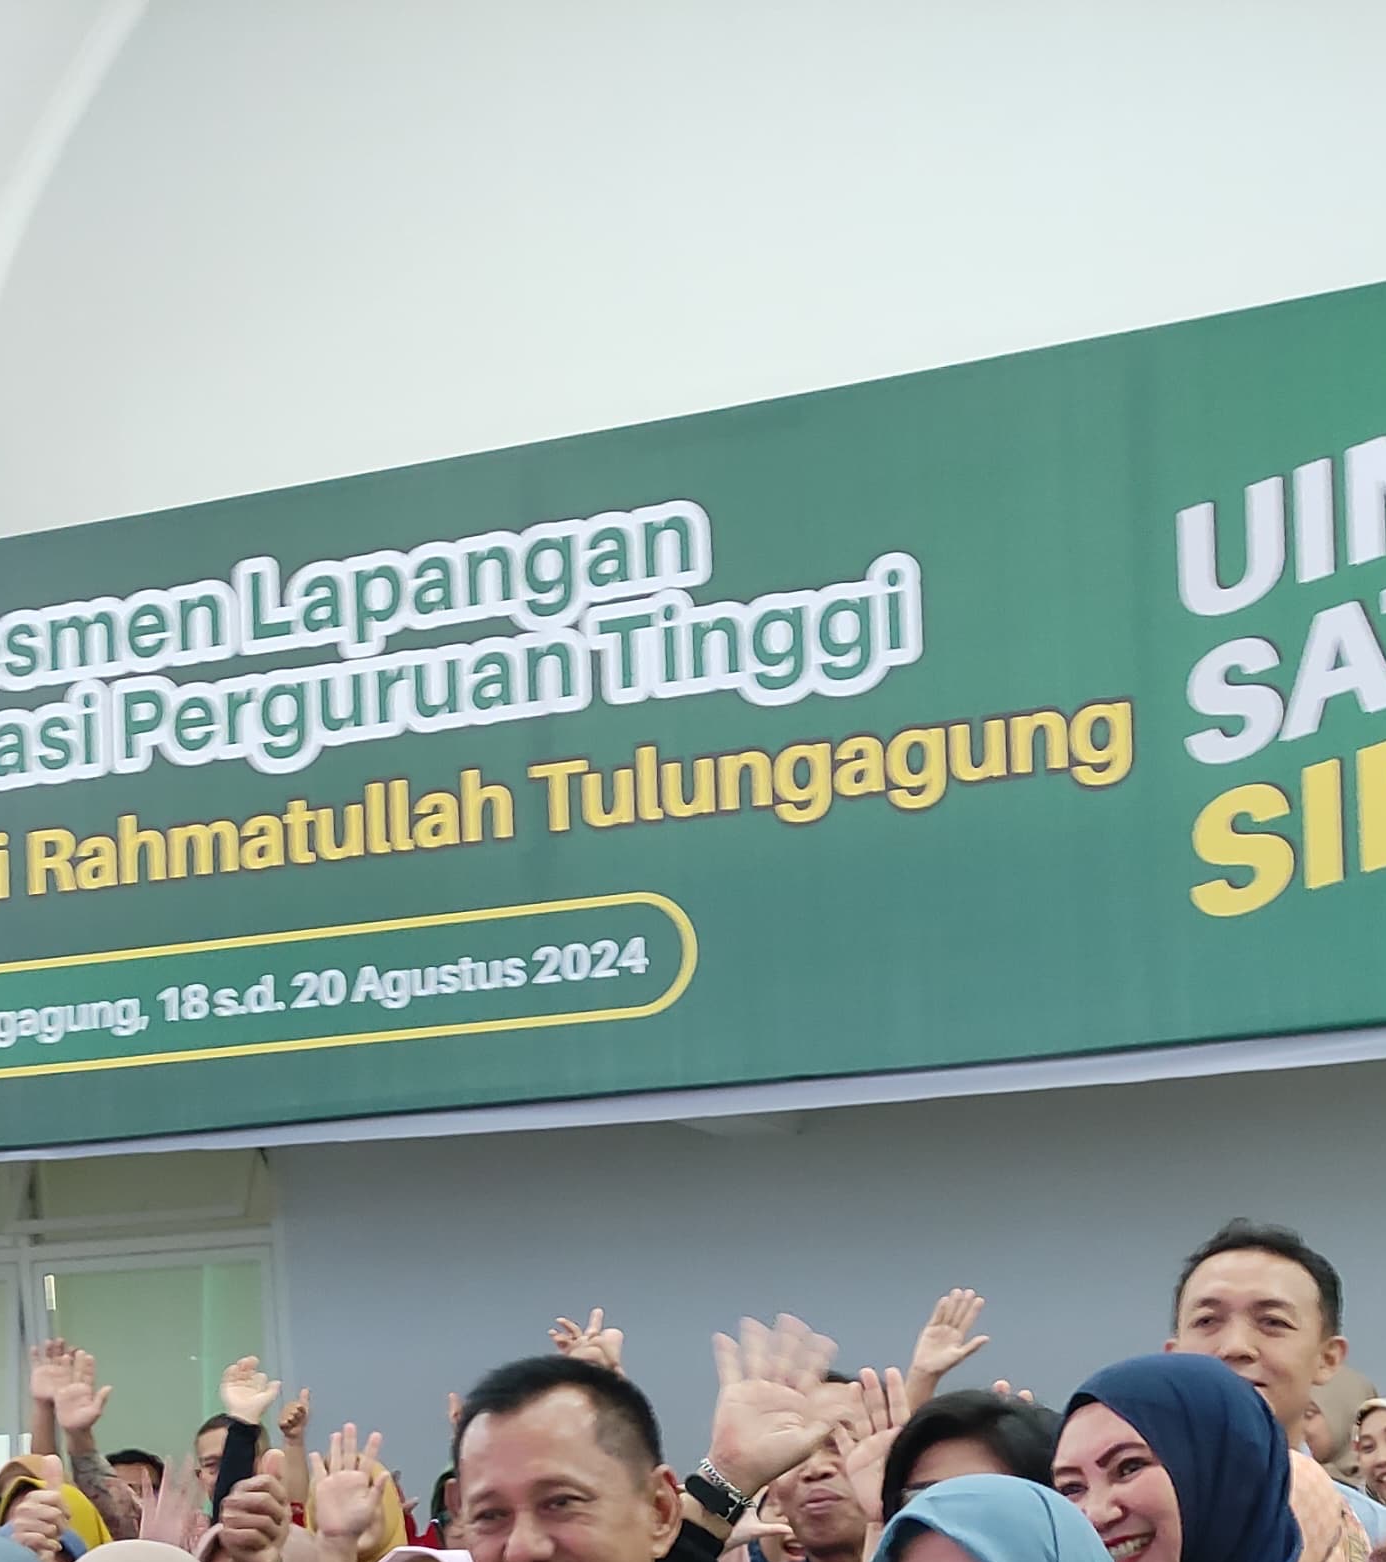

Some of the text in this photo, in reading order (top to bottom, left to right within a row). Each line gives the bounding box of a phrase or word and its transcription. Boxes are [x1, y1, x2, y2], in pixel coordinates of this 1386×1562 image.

[243, 506, 702, 650] Lapangan
[118, 634, 583, 765] Perguruan
[595, 561, 914, 699] Tinggi
[28, 769, 513, 895] Rahmatullah
[528, 700, 1133, 830] Tulungagung
[156, 984, 210, 1022] 18
[213, 975, 286, 1016] s.d.
[290, 969, 347, 1009] 20
[350, 957, 527, 1009] Agustus
[532, 936, 649, 984] 2024
